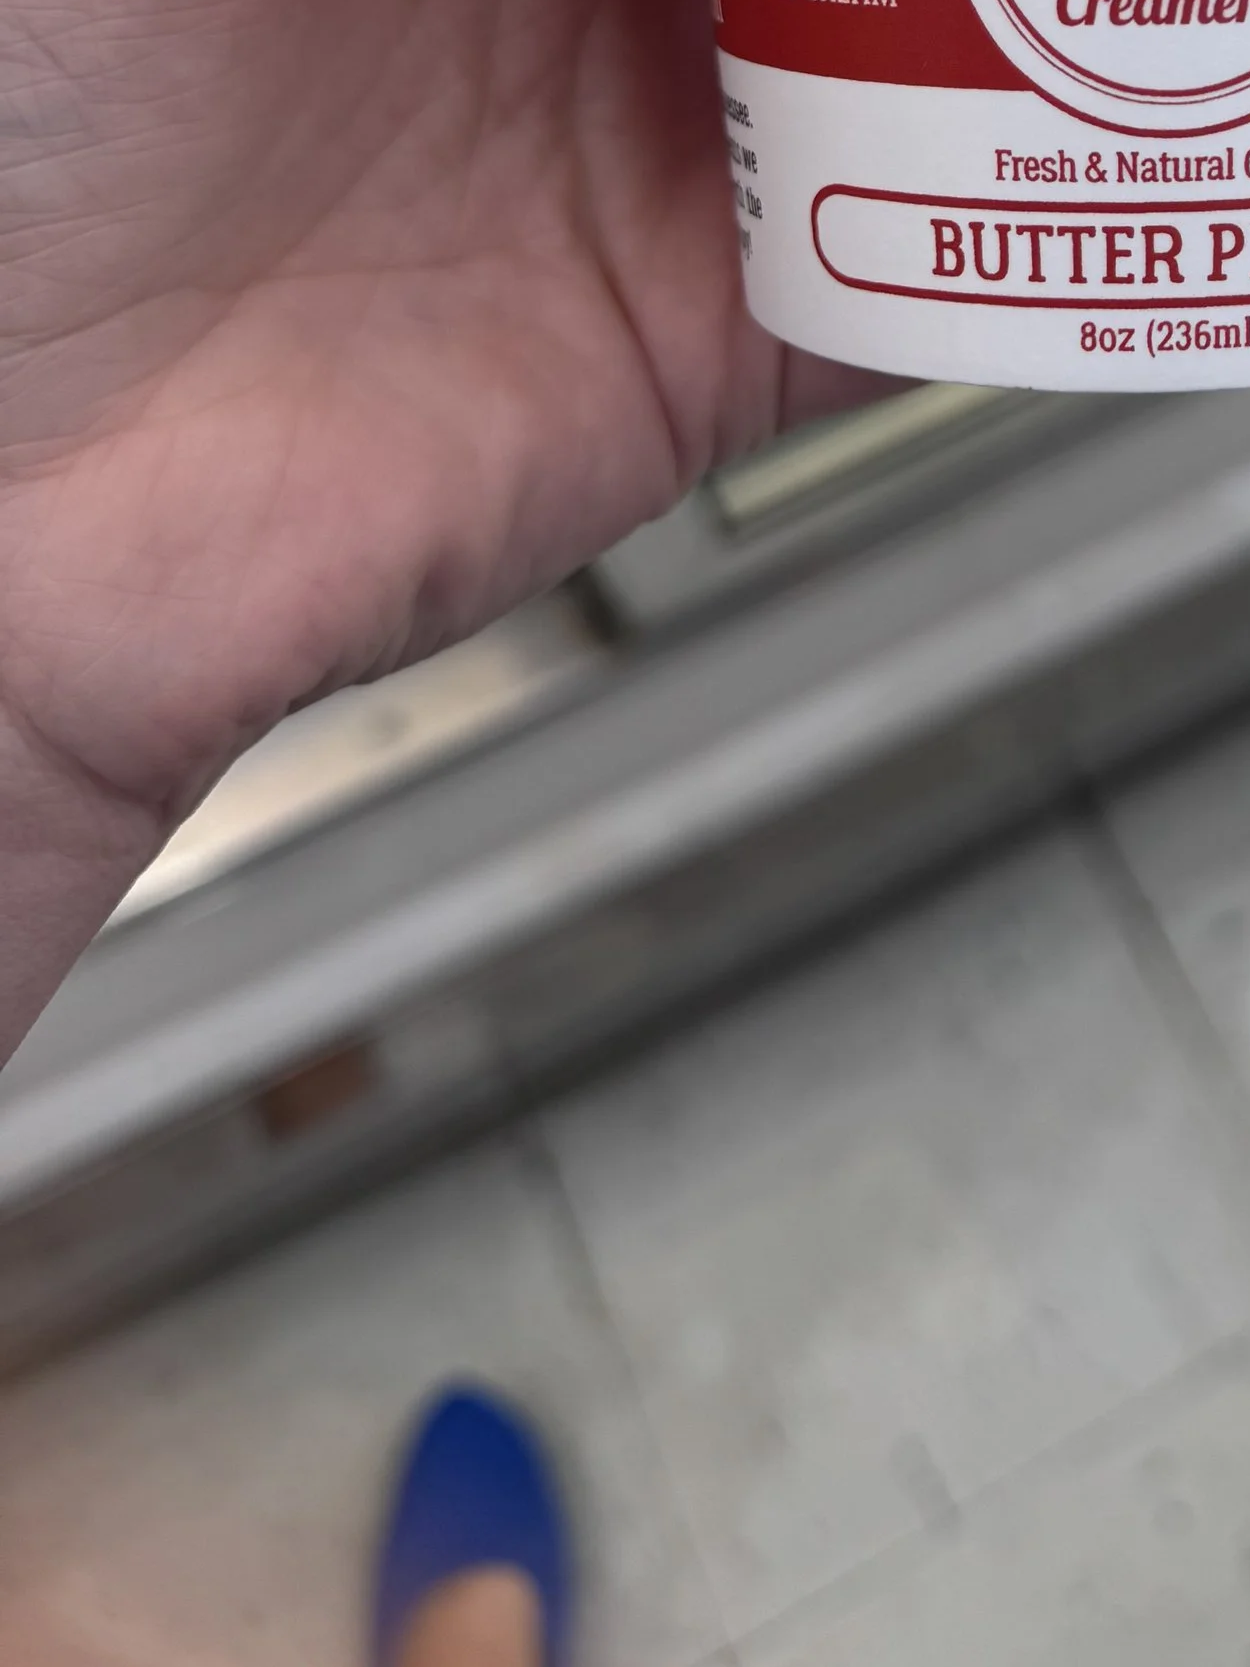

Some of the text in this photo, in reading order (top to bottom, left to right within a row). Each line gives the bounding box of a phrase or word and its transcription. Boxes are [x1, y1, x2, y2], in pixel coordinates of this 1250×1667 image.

[994, 148, 1078, 184] Fresh
[1084, 150, 1109, 184] &
[1115, 146, 1236, 184] Natural
[930, 217, 1185, 285] BUTTER
[1079, 321, 1136, 354] 8oz
